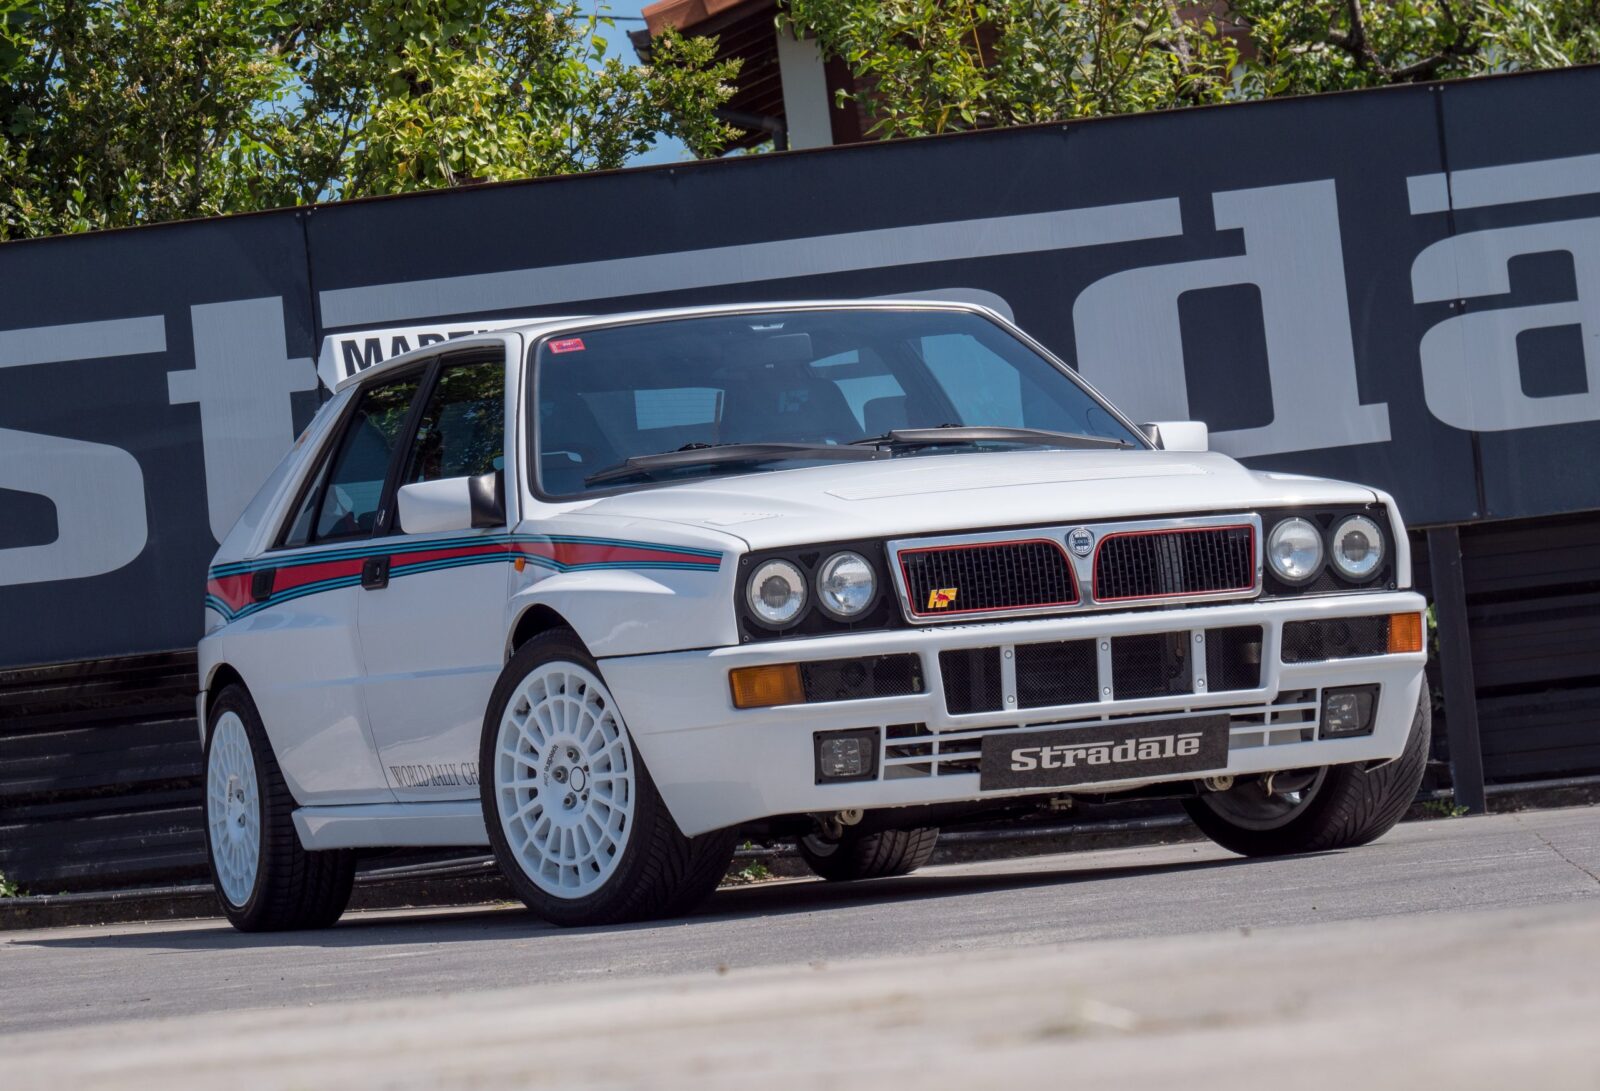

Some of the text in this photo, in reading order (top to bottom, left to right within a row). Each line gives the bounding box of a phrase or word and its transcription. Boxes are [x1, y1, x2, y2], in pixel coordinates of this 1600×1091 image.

[928, 588, 957, 608] HF
[1011, 732, 1203, 771] Stradale
[389, 762, 480, 787] WORLD RALLY CH
